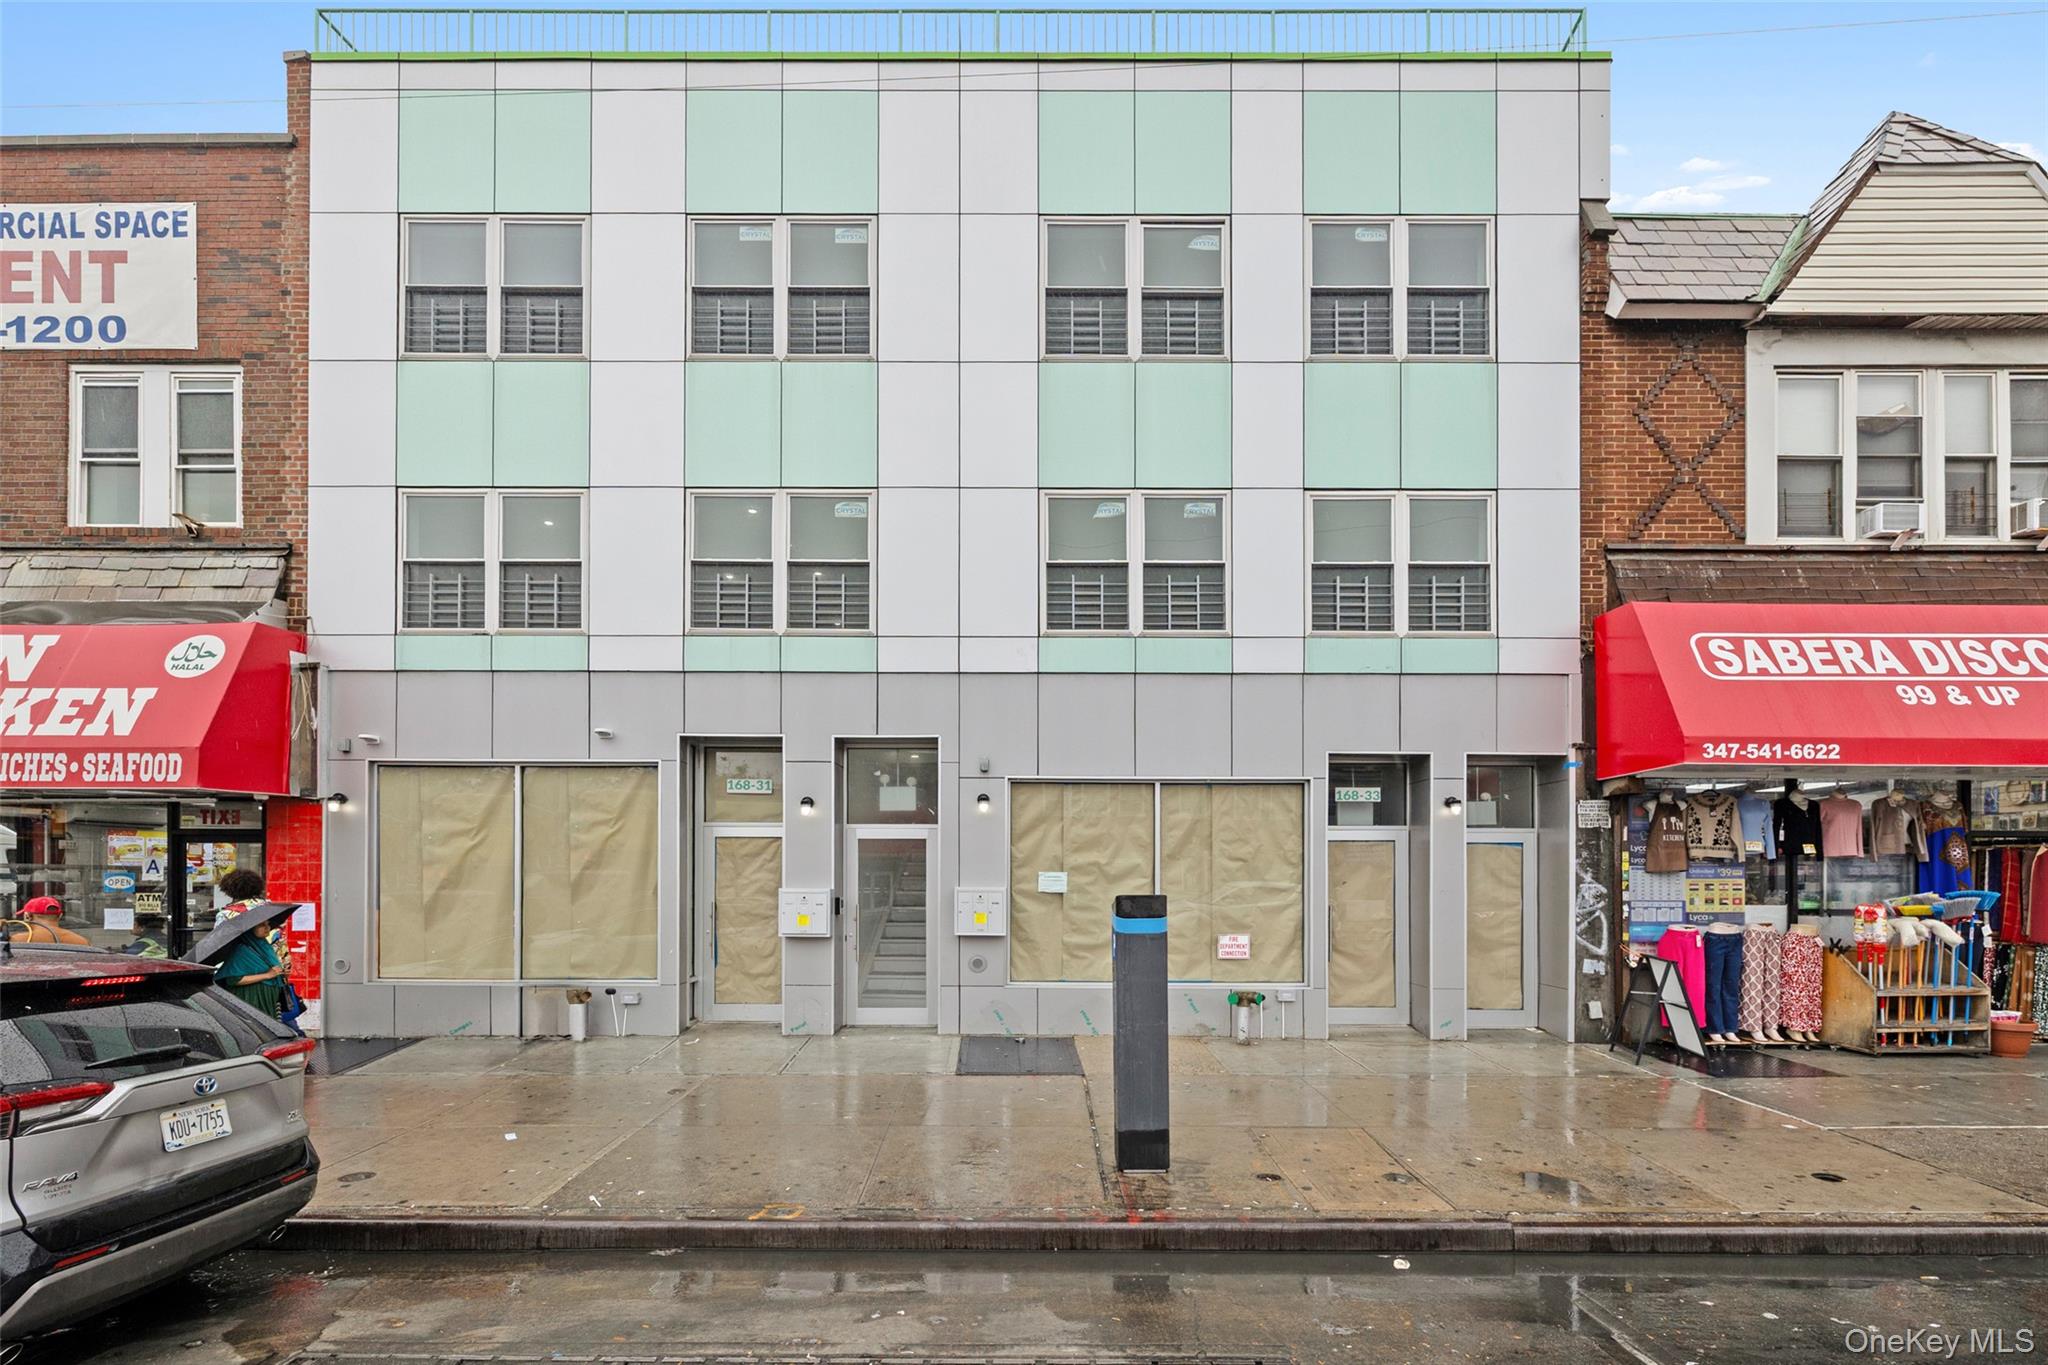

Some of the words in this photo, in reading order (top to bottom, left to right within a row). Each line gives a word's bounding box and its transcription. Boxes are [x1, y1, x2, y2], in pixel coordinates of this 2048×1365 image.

[0, 211, 85, 239] RCIAL
[95, 210, 189, 239] SPACE
[741, 230, 771, 239] CRYSTAL
[836, 233, 866, 241] CRYSTAL
[0, 250, 128, 304] ENT
[836, 507, 866, 515] CRYSTAL
[0, 634, 60, 682] N
[1708, 638, 1910, 675] SABERA
[170, 663, 206, 671] HALAL
[1895, 684, 1937, 706] 99
[1945, 684, 1972, 706] &
[1974, 685, 2021, 706] UP
[0, 687, 159, 736] KEN
[1702, 743, 1840, 760] 347-541-6622
[728, 780, 772, 790] 168-31
[1336, 789, 1381, 800] 168-33
[146, 860, 160, 874] A
[107, 879, 132, 887] OPEN
[137, 894, 161, 902] ATM
[1689, 913, 1709, 922] Lyca
[178, 1109, 193, 1118] NEW
[194, 1105, 211, 1115] YORK
